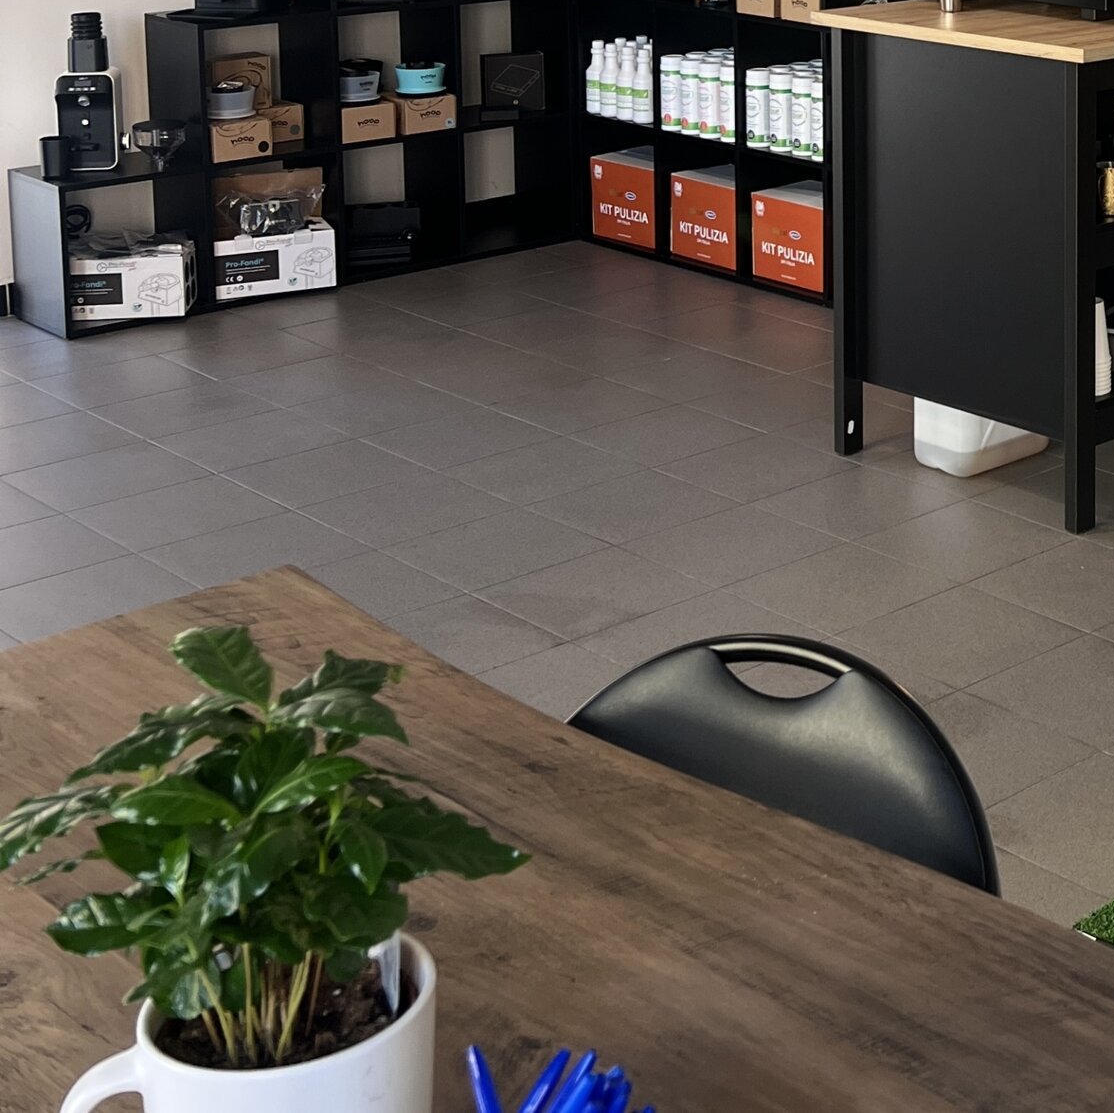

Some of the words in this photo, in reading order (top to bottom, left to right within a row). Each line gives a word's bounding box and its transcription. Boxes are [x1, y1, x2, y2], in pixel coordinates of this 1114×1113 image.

[600, 202, 614, 216] KIT
[614, 206, 649, 225] PULIZIA
[680, 221, 693, 235] KIT
[694, 225, 729, 244] PULIZIA
[761, 241, 777, 256] KIT
[777, 245, 815, 266] PULIZIA
